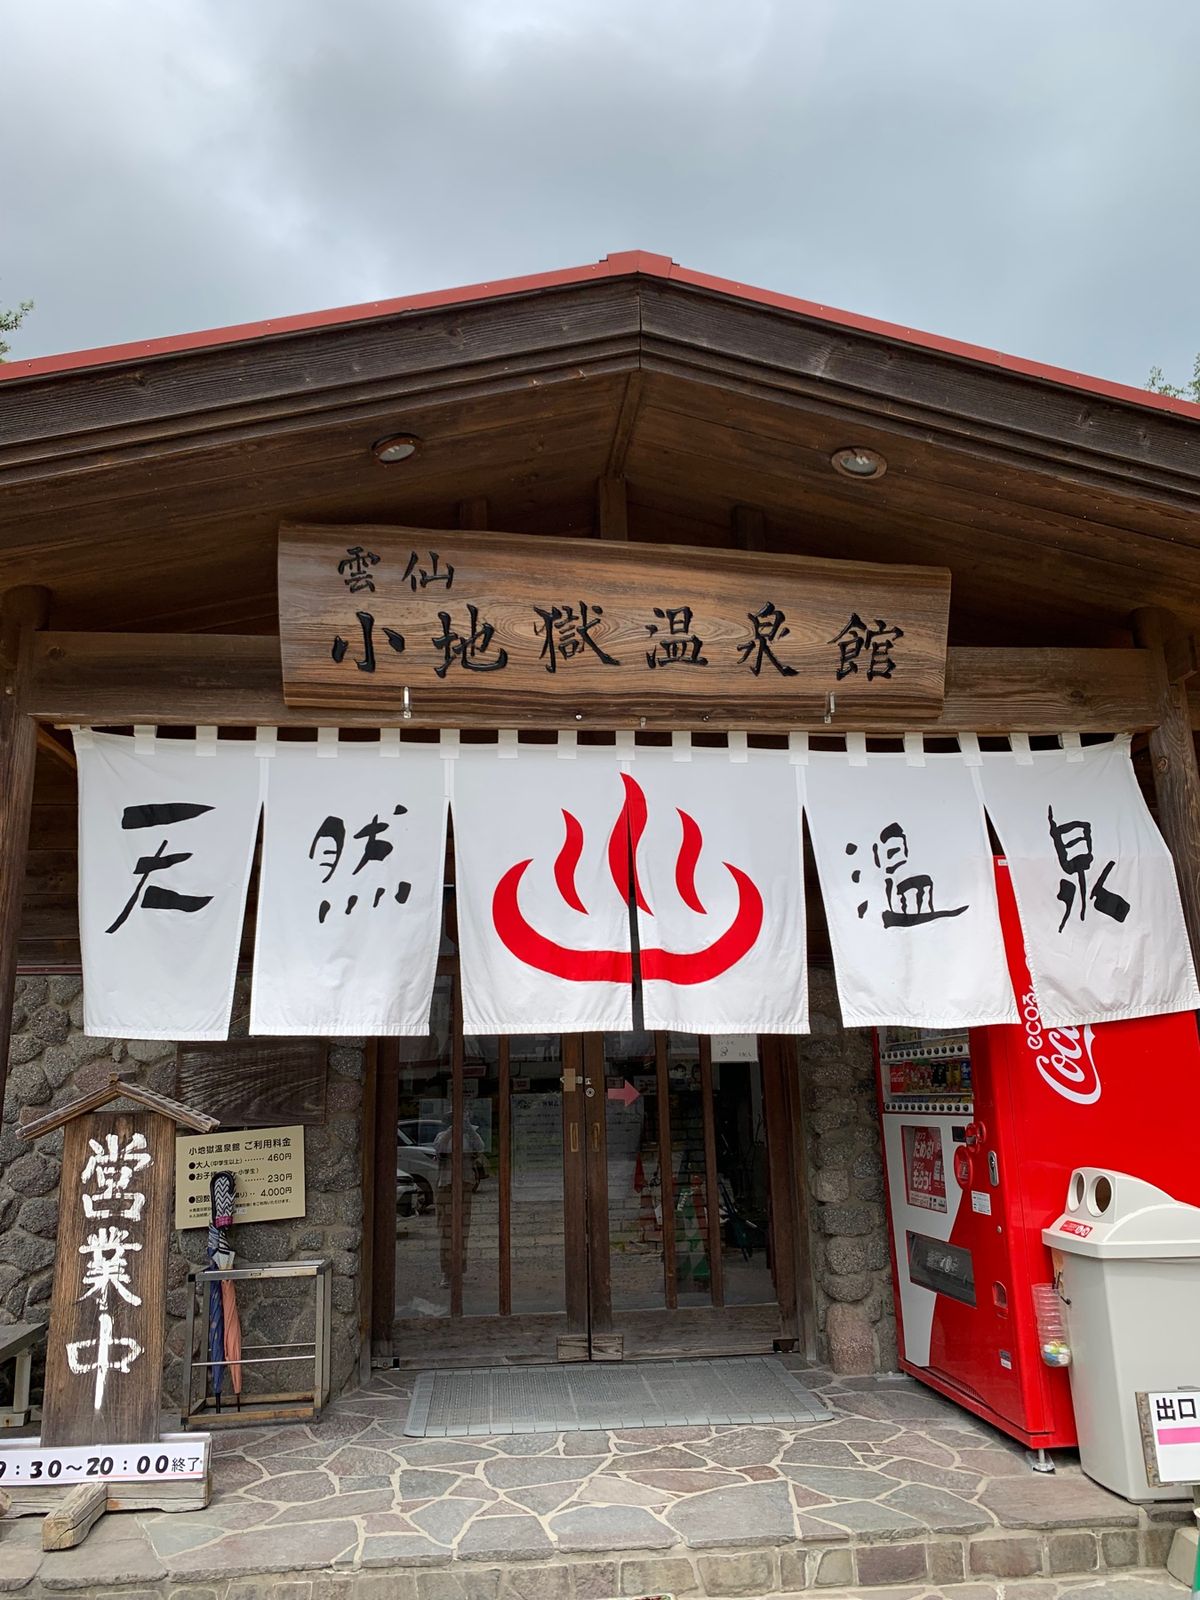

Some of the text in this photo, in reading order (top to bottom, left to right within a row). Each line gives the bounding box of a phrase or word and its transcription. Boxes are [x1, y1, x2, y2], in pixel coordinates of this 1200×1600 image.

[338, 546, 454, 593] 雲仙
[332, 600, 905, 682] 小地獄温泉館
[105, 802, 1130, 934] 天然 温泉
[188, 1137, 292, 1156] 小地獄温泉館 ご利用料金
[267, 1152, 292, 1162] 460円
[267, 1173, 293, 1183] 230円
[65, 1132, 155, 1410] 営業中
[1155, 1397, 1197, 1422] 出口
